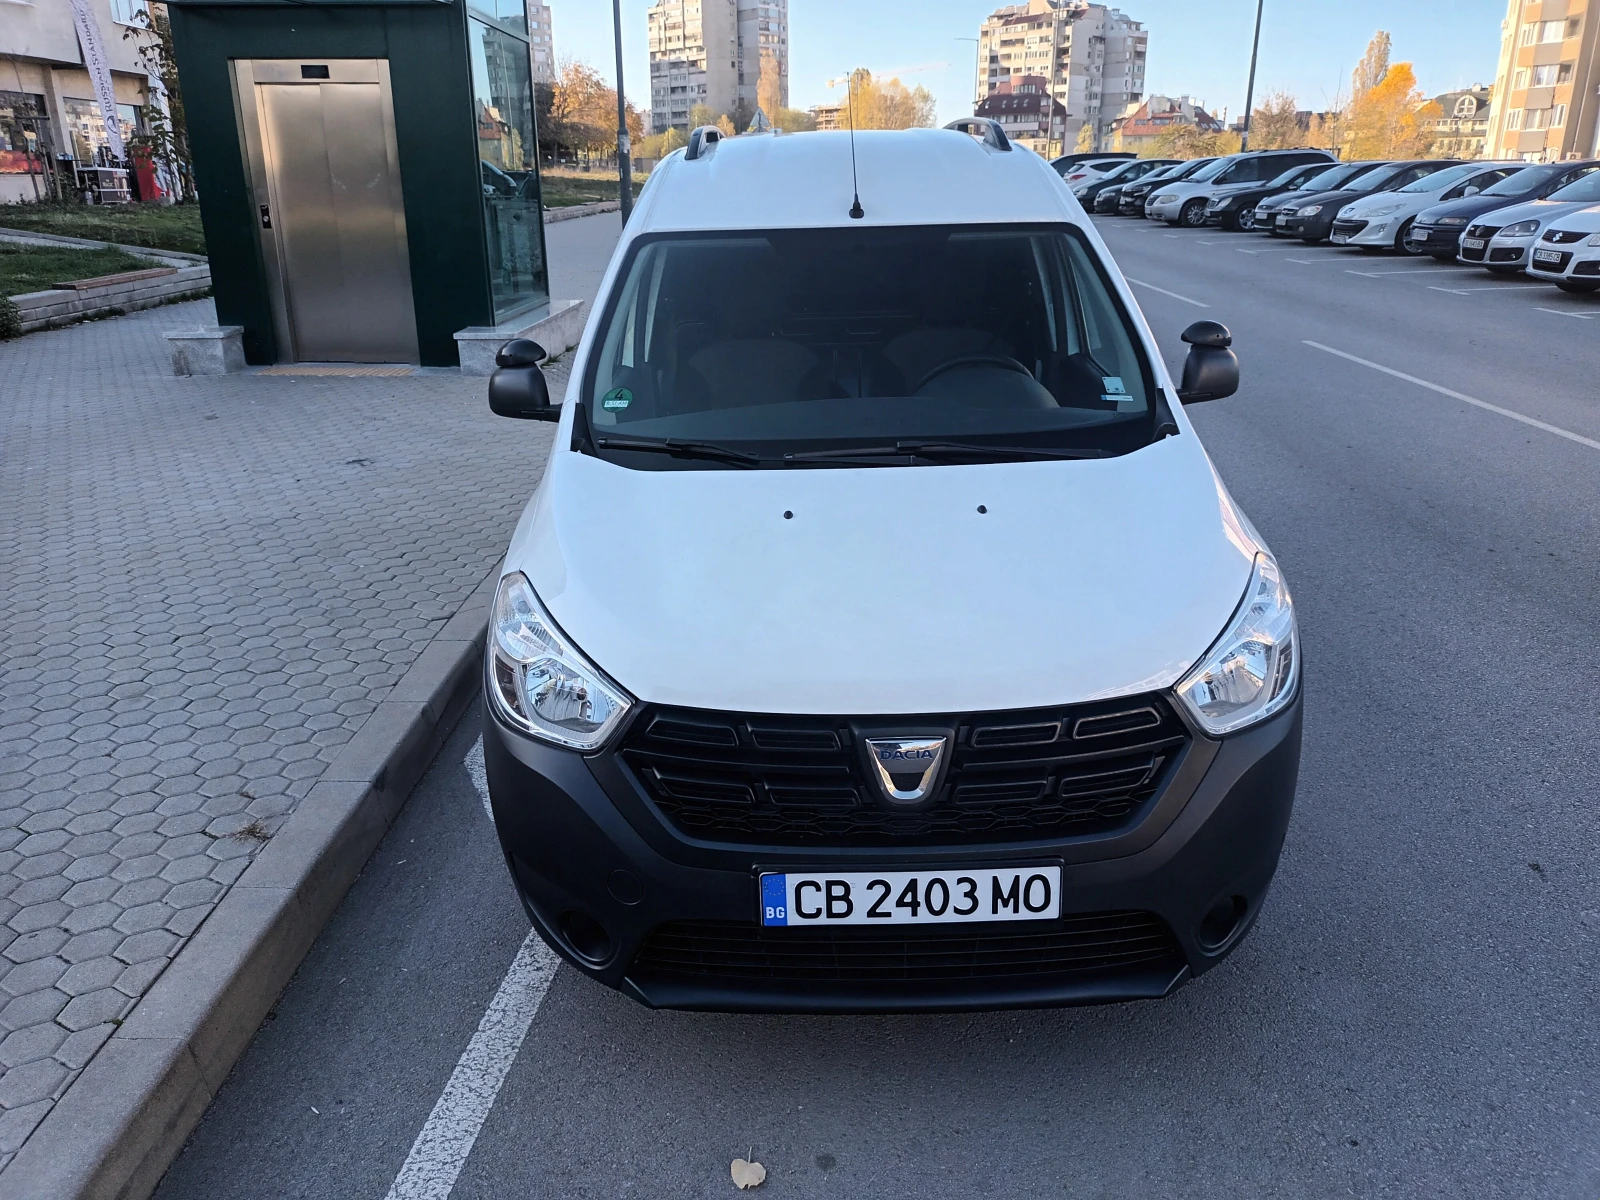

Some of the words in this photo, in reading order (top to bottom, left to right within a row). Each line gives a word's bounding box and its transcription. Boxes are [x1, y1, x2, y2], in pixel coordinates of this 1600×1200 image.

[80, 9, 100, 66] STANDARD
[96, 67, 114, 112] RUSSIAN
[614, 389, 623, 400] 4
[880, 750, 933, 760] DACIA
[794, 879, 854, 919] CB
[866, 877, 980, 919] 2403
[991, 873, 1052, 915] MO
[765, 906, 785, 919] BG
